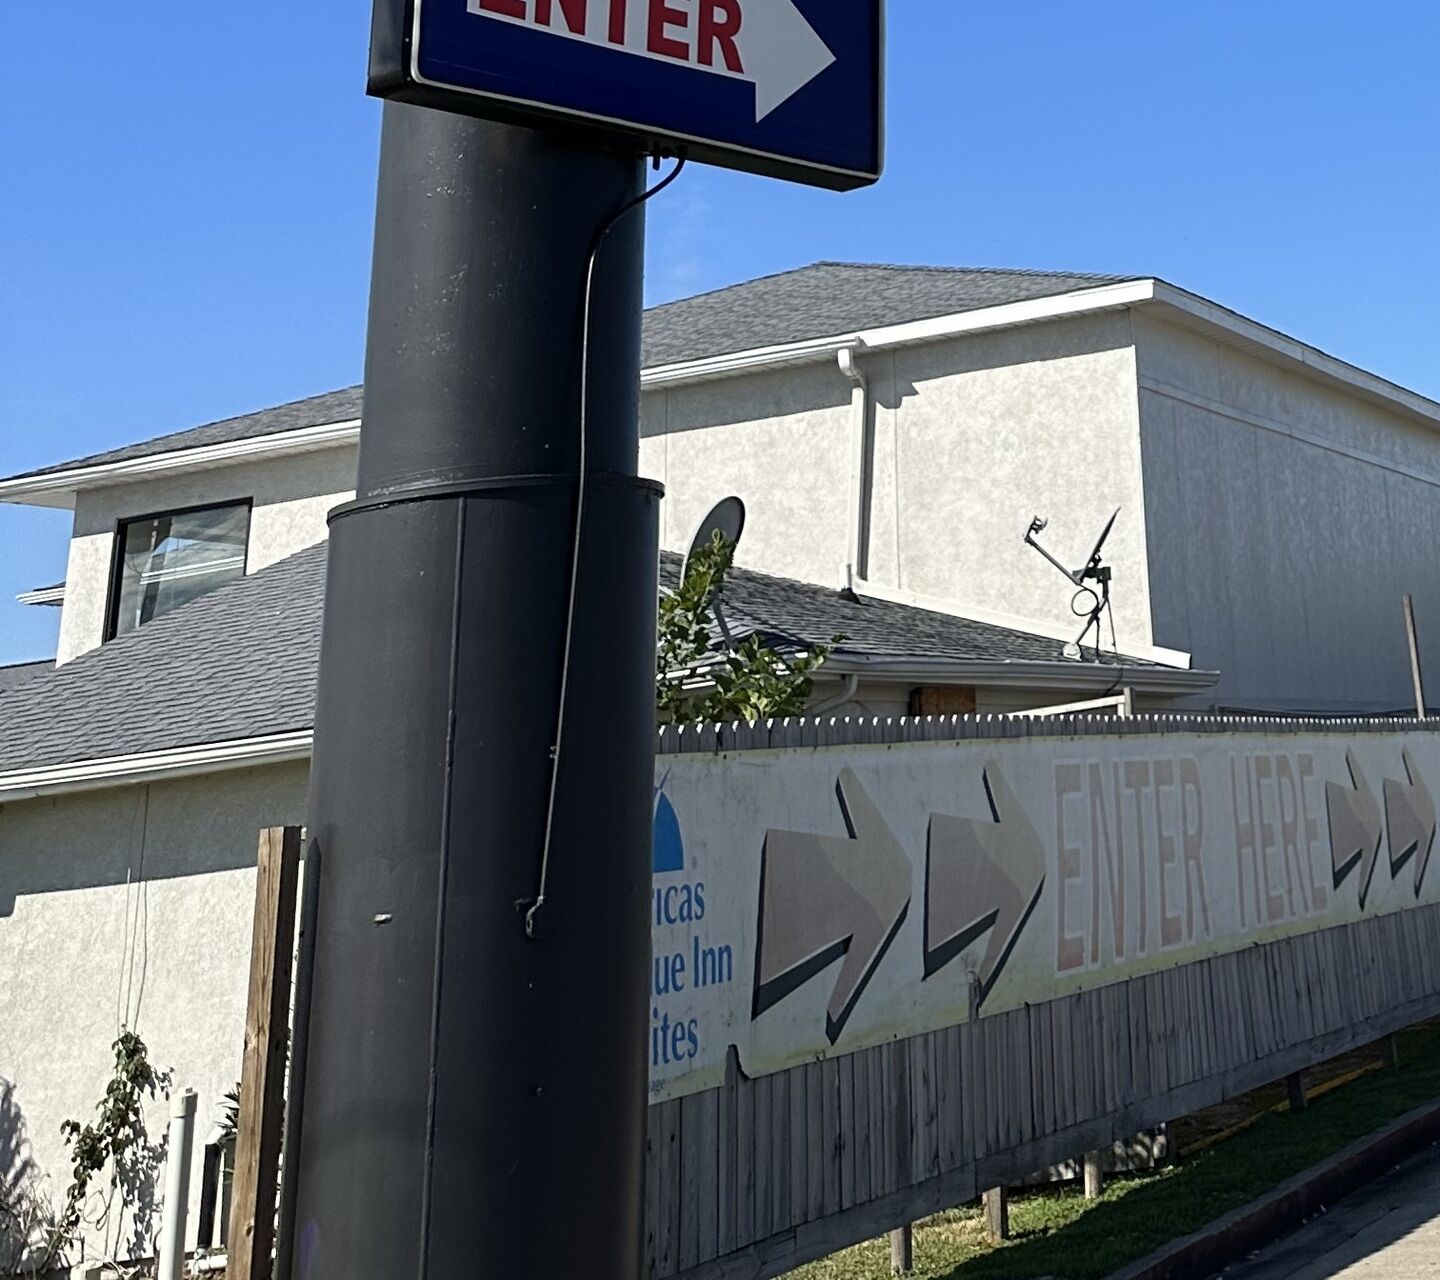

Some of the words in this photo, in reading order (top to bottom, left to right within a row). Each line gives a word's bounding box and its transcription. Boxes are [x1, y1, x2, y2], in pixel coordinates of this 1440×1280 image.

[1053, 756, 1212, 975] ENTER
[1228, 751, 1328, 932] HERE
[652, 881, 705, 926] icas
[693, 935, 733, 988] Inn
[652, 1007, 699, 1066] ites
